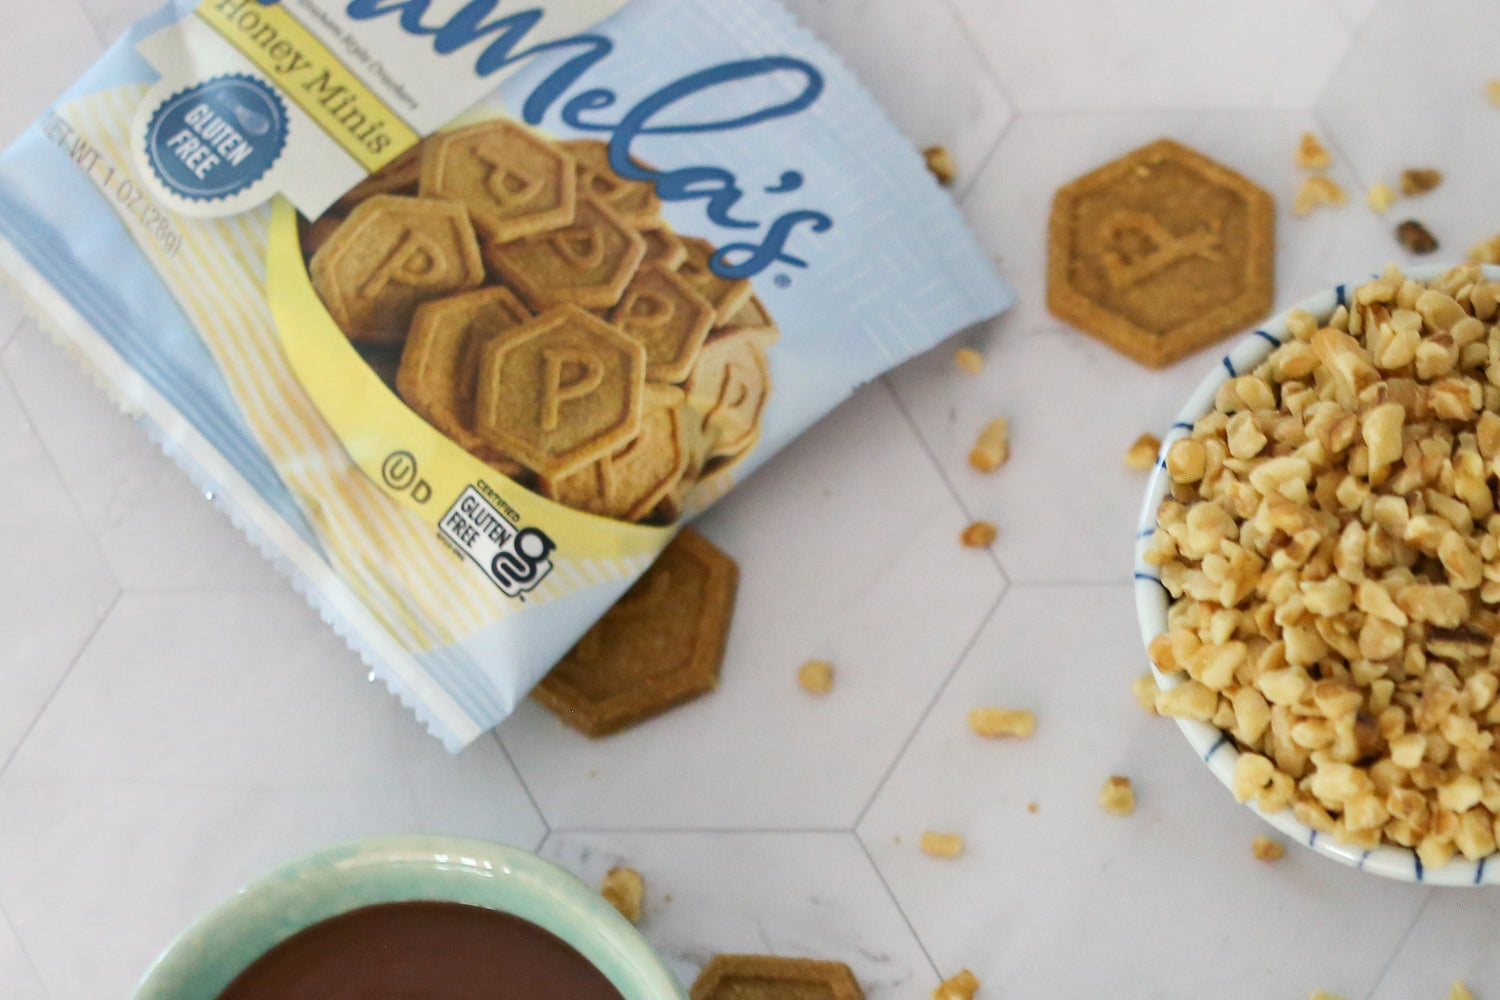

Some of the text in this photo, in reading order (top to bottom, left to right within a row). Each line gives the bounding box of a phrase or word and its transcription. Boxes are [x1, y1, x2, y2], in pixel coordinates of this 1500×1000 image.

[215, 0, 311, 73] Honey
[305, 69, 391, 154] Minis
[166, 129, 221, 179] FREE
[184, 103, 253, 167] GLUTEN
[460, 495, 512, 548] GLUTEN
[477, 479, 520, 523] CERTIFIED
[446, 511, 480, 548] FREE
